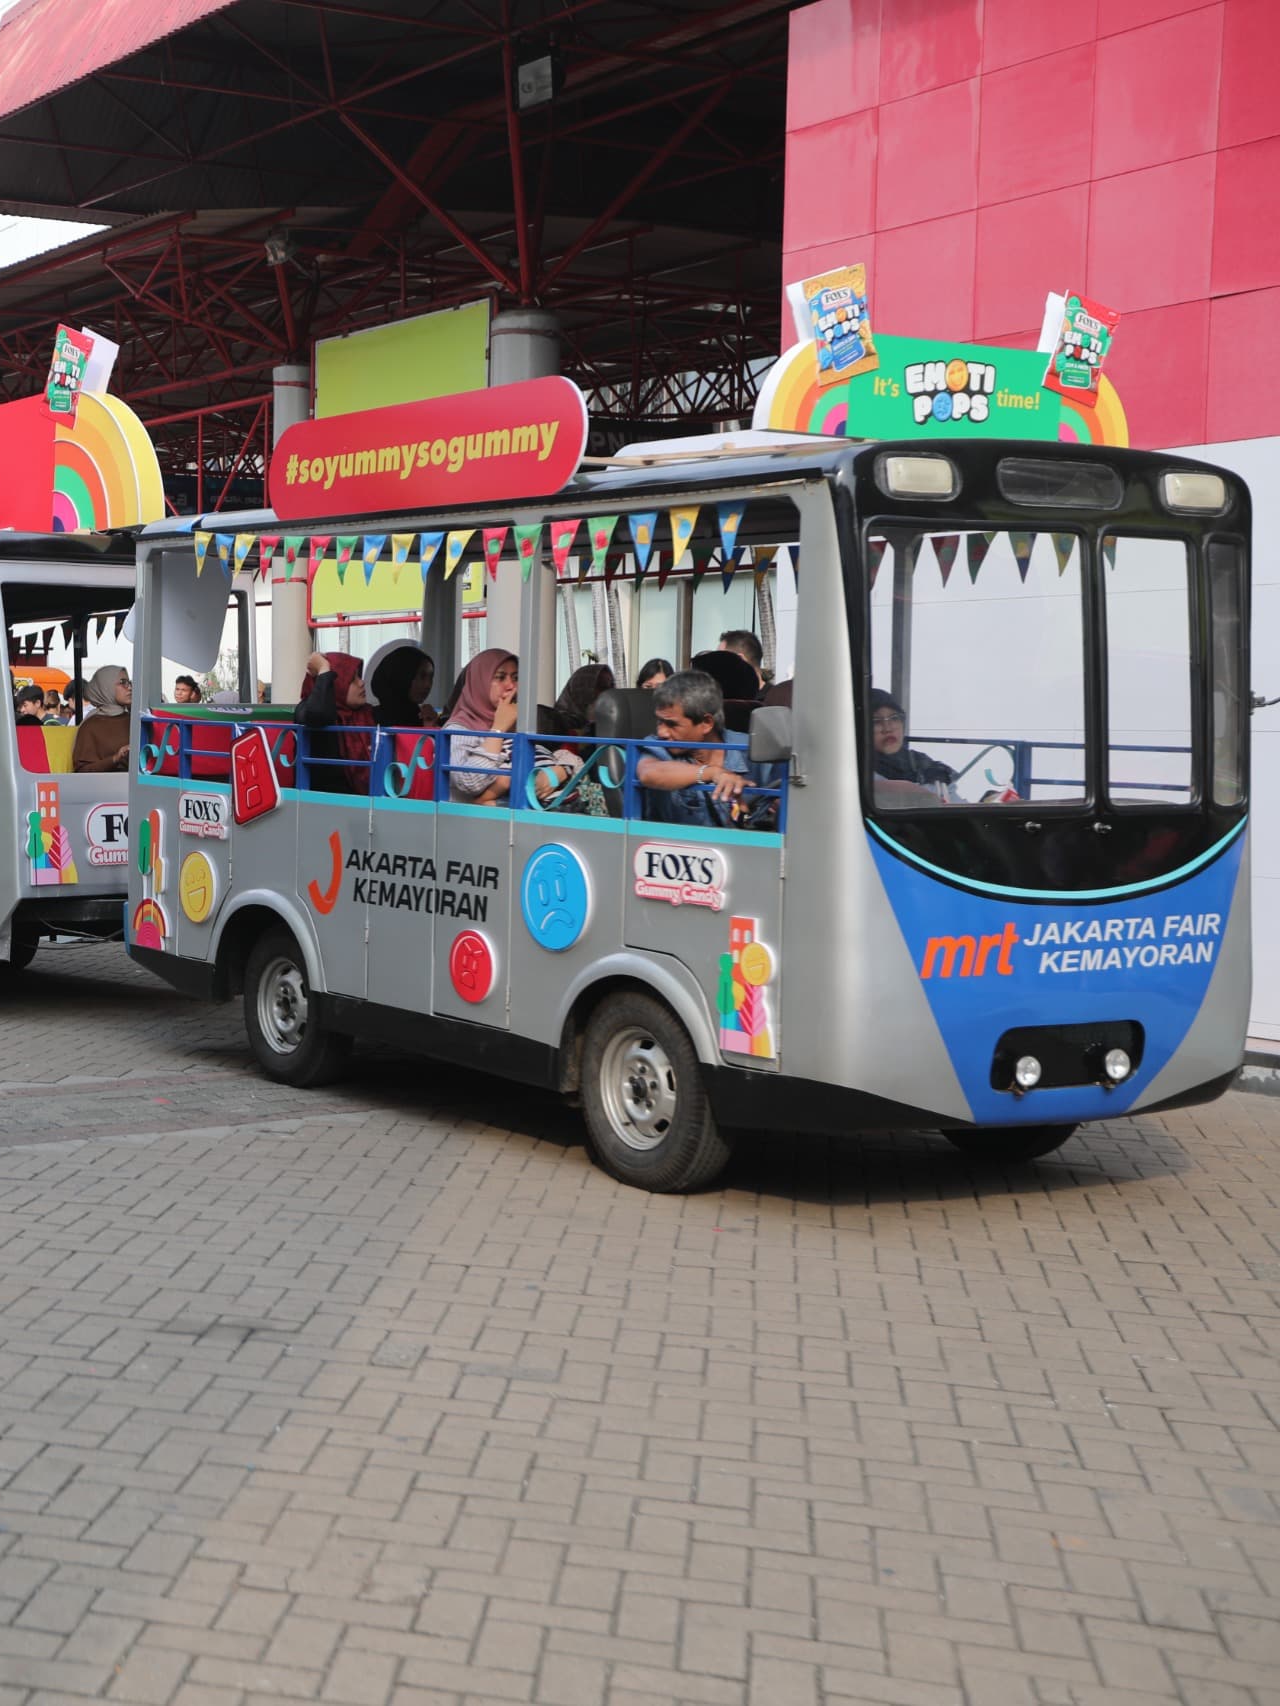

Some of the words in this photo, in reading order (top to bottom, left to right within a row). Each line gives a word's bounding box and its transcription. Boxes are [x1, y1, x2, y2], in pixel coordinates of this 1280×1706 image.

[873, 376, 900, 397] It's
[913, 392, 989, 424] POPS
[996, 389, 1041, 410] time!
[285, 421, 559, 489] #soyummysogummy
[184, 799, 220, 823] FOX'S
[180, 821, 203, 837] Gummy
[204, 823, 225, 839] Candy
[445, 860, 500, 890] FAIR
[644, 851, 714, 885] FOX'S
[353, 877, 489, 922] KEMAYORAN
[635, 881, 680, 904] Gummy
[681, 885, 721, 911] Candy
[1024, 917, 1156, 946] JAKARTA
[1163, 913, 1221, 938] FAIR
[919, 922, 1020, 979] mrt
[1039, 941, 1214, 974] KEMAYORAN
